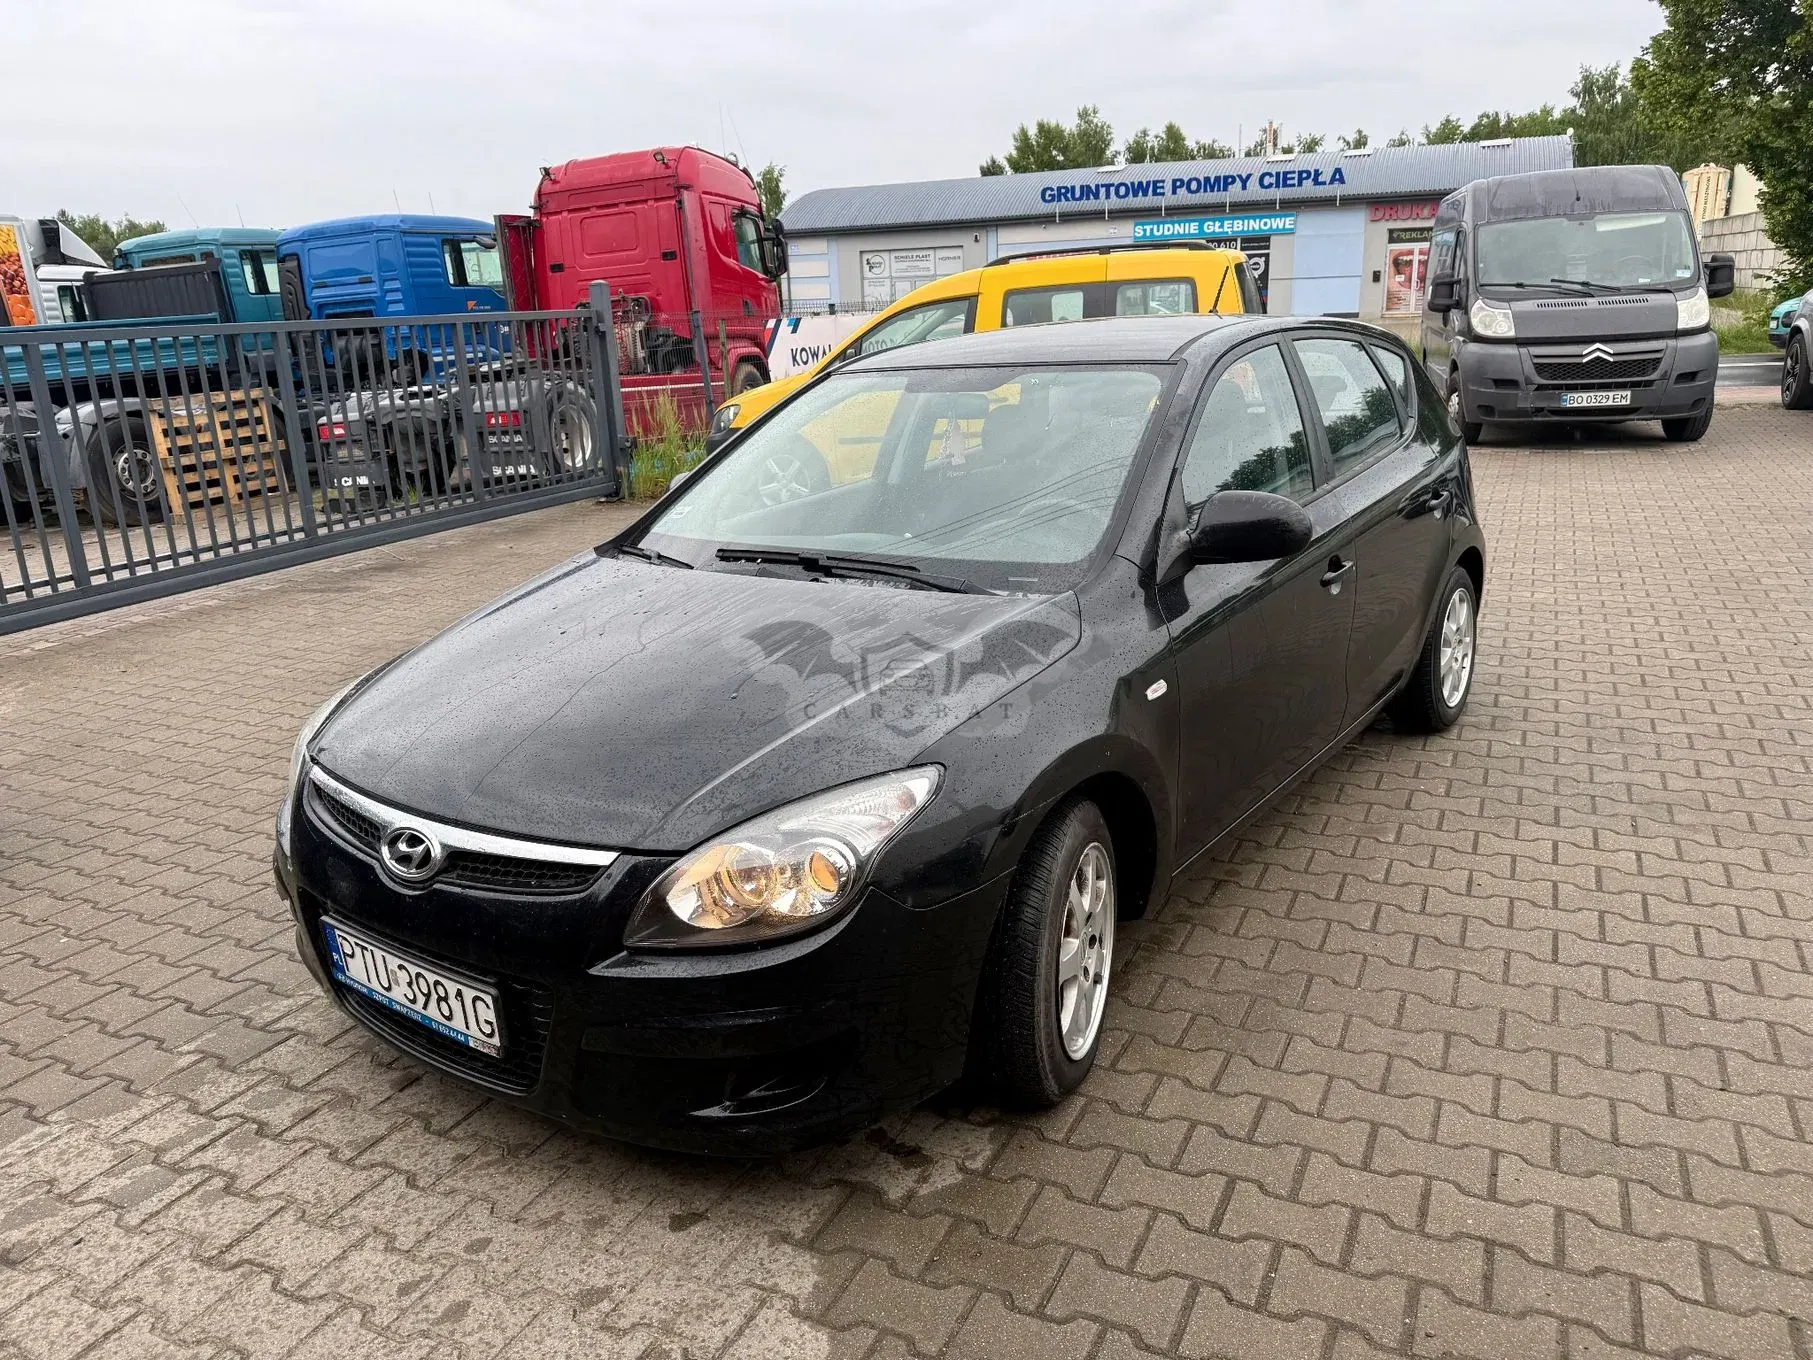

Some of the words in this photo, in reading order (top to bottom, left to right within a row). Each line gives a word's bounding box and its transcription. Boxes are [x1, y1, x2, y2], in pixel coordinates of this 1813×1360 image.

[1040, 178, 1166, 203] GRUNTOWE
[1171, 173, 1253, 195] POMPY
[1258, 167, 1346, 190] CIEPŁA
[1134, 222, 1199, 237] STUDNIE
[1203, 216, 1295, 234] GŁĘBINOWE
[1568, 395, 1584, 405] BO
[1585, 394, 1610, 405] 0329
[1612, 393, 1629, 404] EM
[332, 952, 343, 966] PL
[337, 934, 392, 993] PTU
[397, 963, 496, 1039] 3981G
